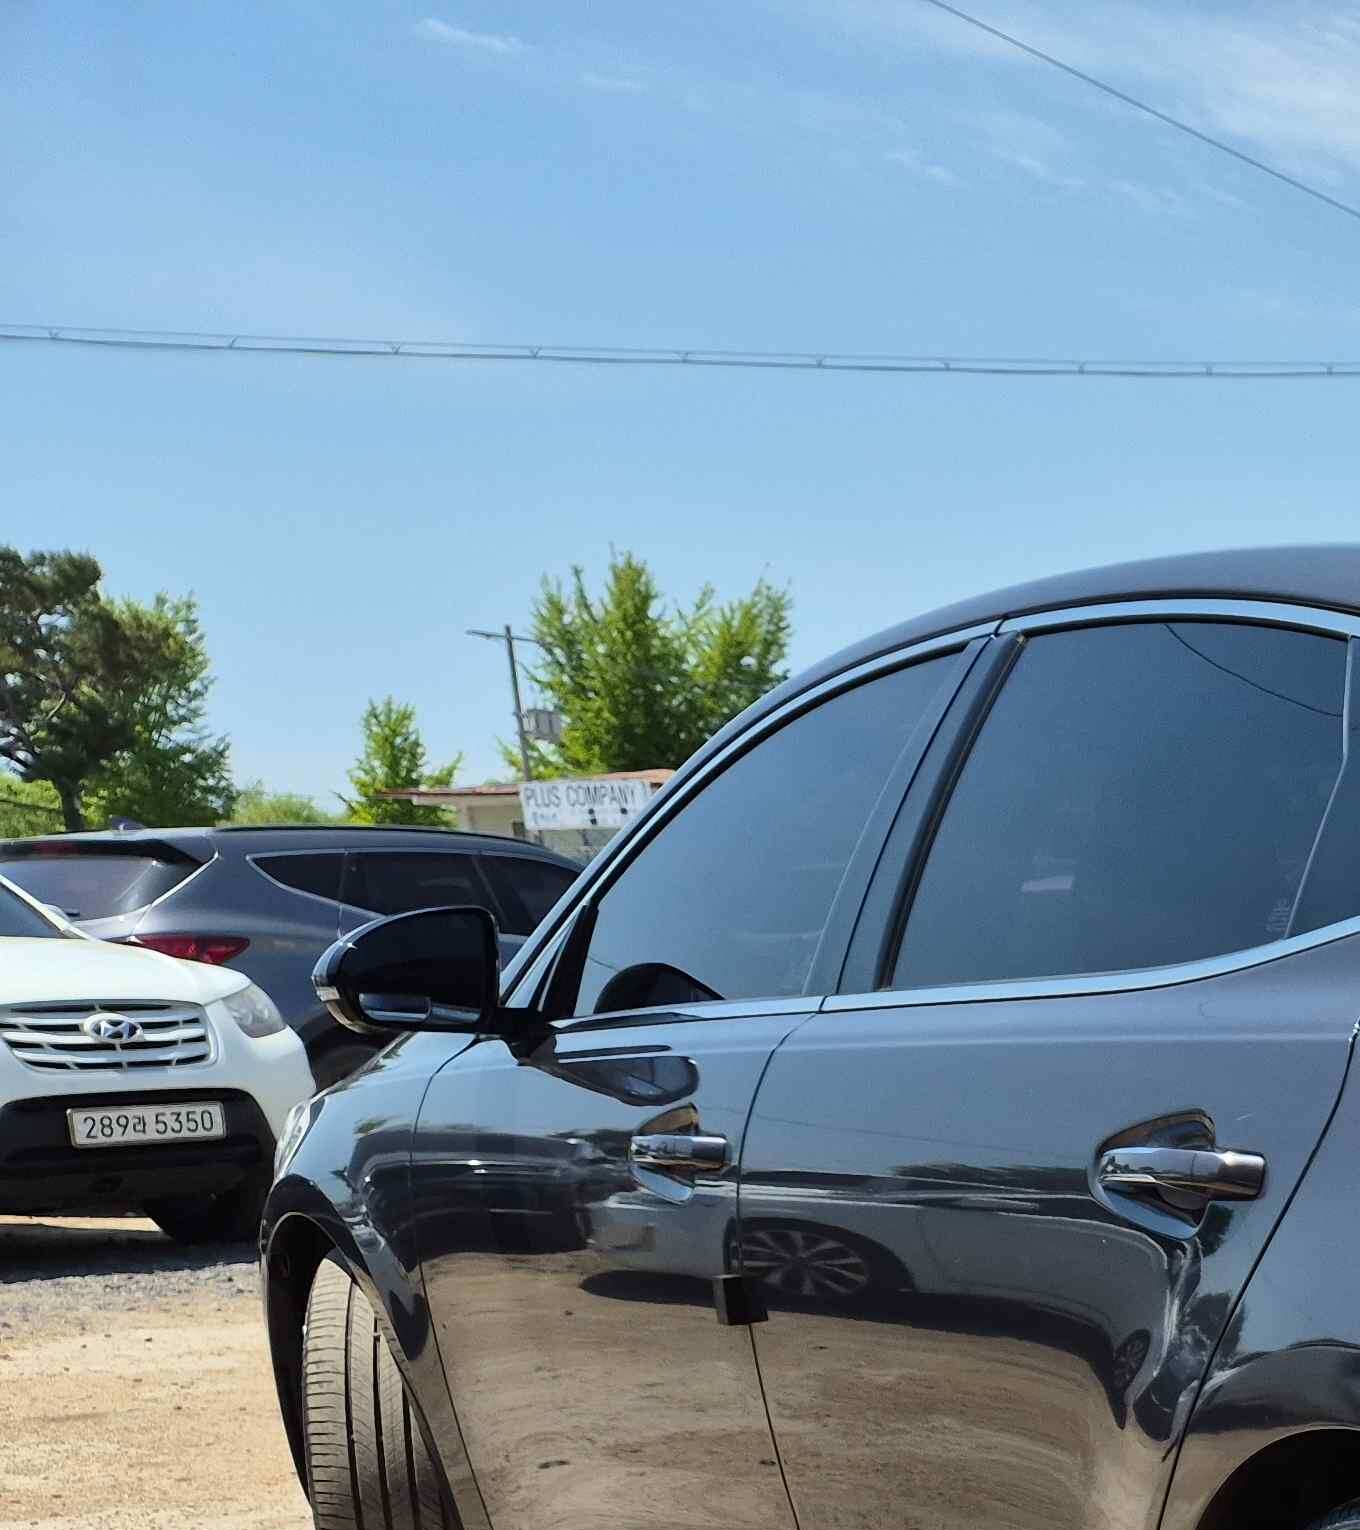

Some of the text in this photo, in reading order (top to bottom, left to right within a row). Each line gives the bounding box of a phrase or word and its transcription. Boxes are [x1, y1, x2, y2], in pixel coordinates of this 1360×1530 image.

[524, 782, 636, 808] PLUS COMPANY
[83, 1109, 214, 1139] 289라 5350
